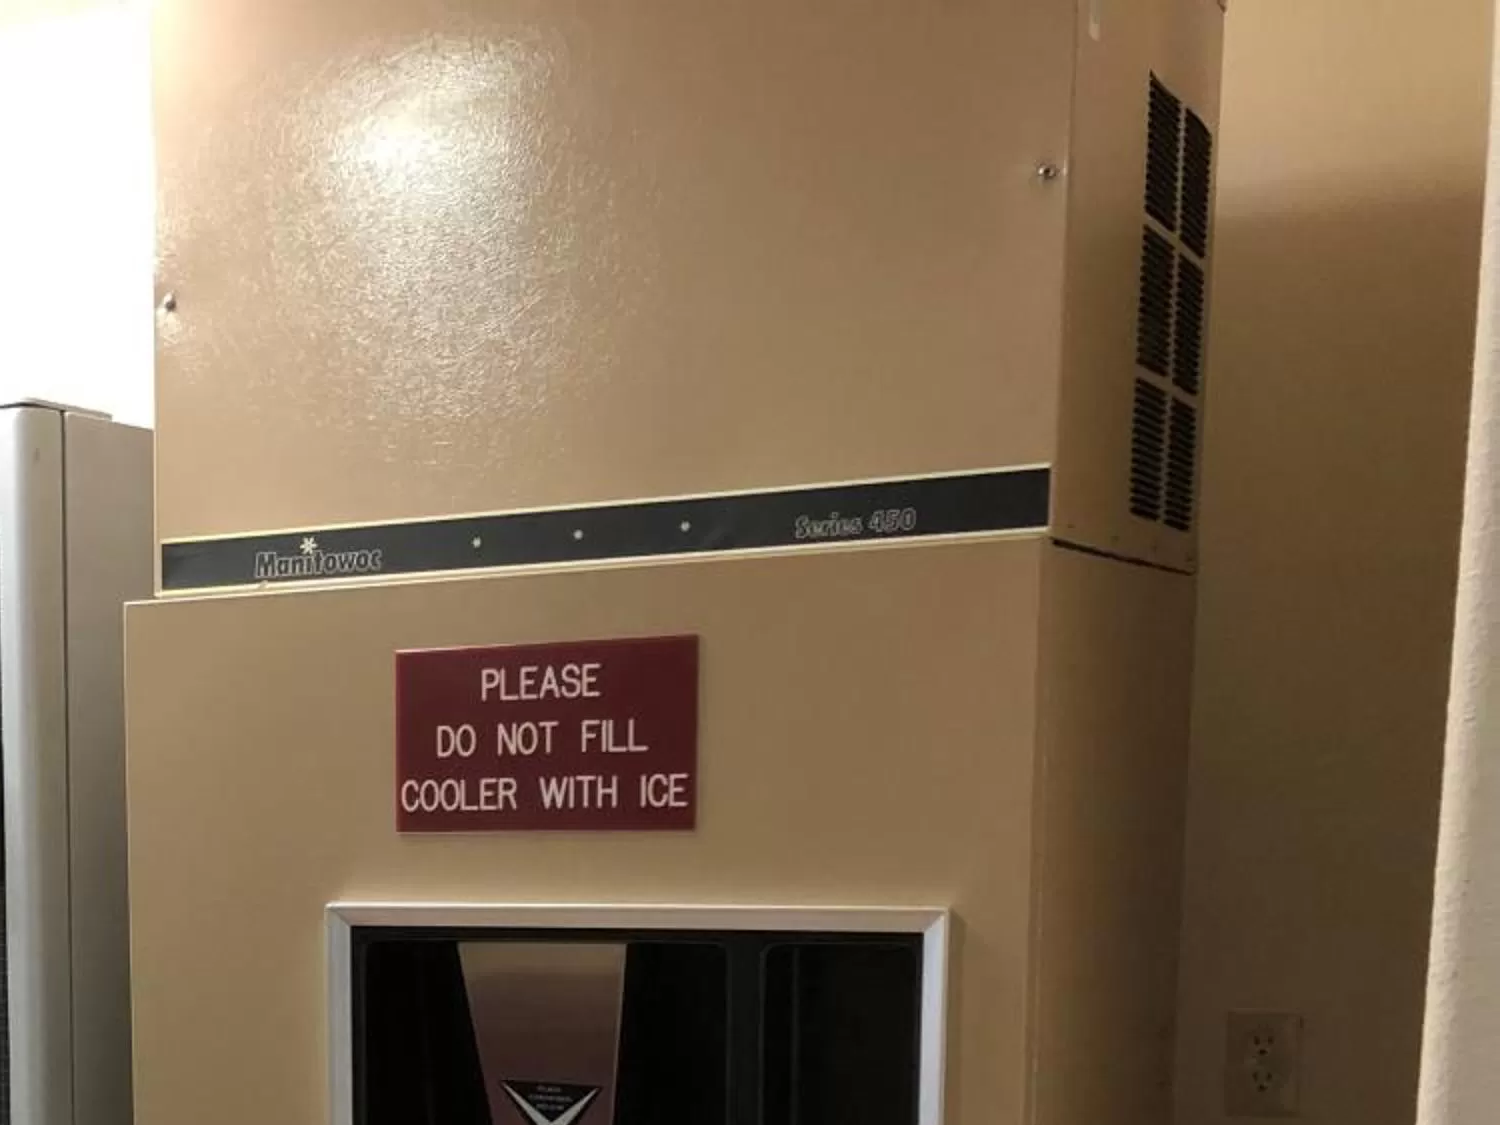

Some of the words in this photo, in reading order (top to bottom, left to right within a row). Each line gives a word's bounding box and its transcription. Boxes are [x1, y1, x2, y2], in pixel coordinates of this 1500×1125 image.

[868, 506, 918, 534] 450
[254, 547, 383, 579] Manitowoc
[481, 663, 601, 702] PLEASE
[436, 723, 477, 759] DO
[497, 721, 559, 756] NOT
[581, 718, 649, 753] FILL
[401, 776, 518, 813] COOLER
[539, 774, 619, 810] WITH
[640, 772, 689, 809] ICE
